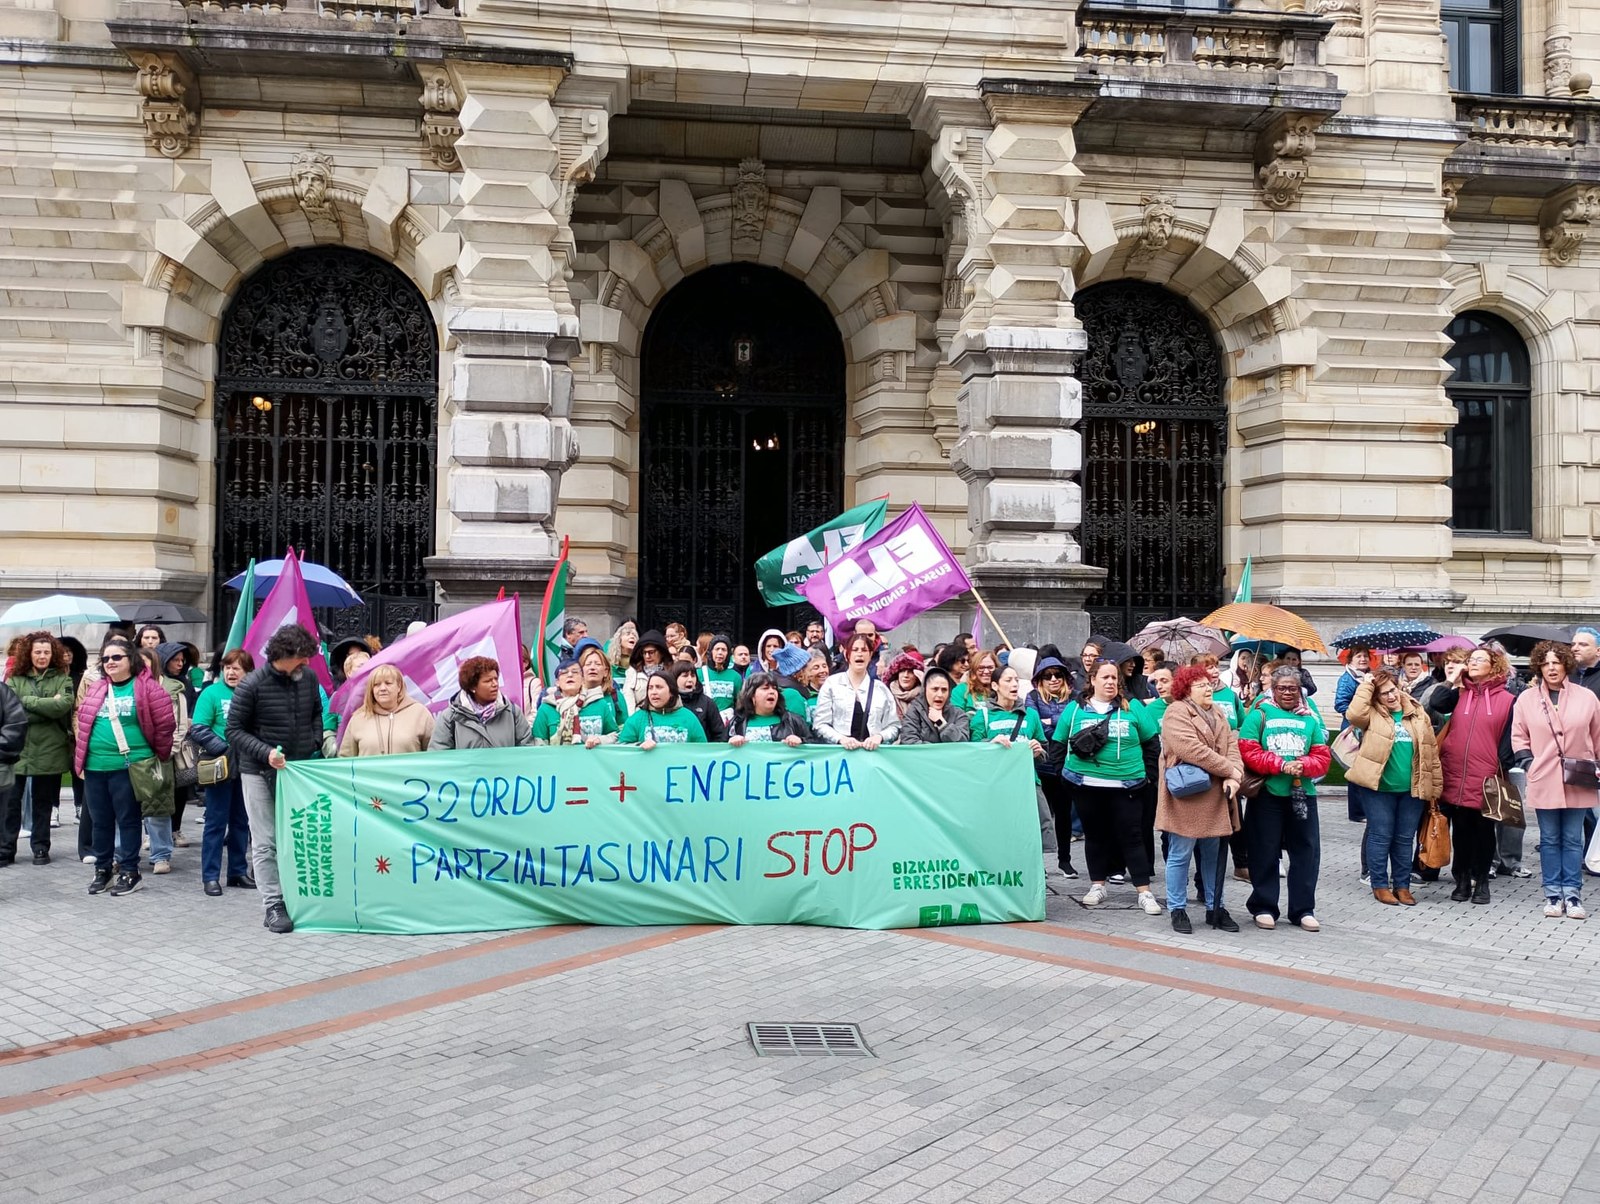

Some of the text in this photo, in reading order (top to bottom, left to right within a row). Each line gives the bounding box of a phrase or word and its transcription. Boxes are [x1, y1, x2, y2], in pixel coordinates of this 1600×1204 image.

[402, 778, 460, 823] 32
[470, 775, 556, 818] ORDU
[665, 758, 854, 803] ENPLEGUA
[290, 807, 309, 897] ZAINTZEAK
[306, 799, 321, 897] GAIXOTASUNA
[317, 793, 334, 897] DAKARRENEAN
[411, 822, 877, 888] PARTZIALTASUNARI STOP
[892, 858, 960, 875] BIZKAIKO
[892, 869, 1024, 891] ERRESIDENTZIAK
[918, 902, 982, 928] ELA
